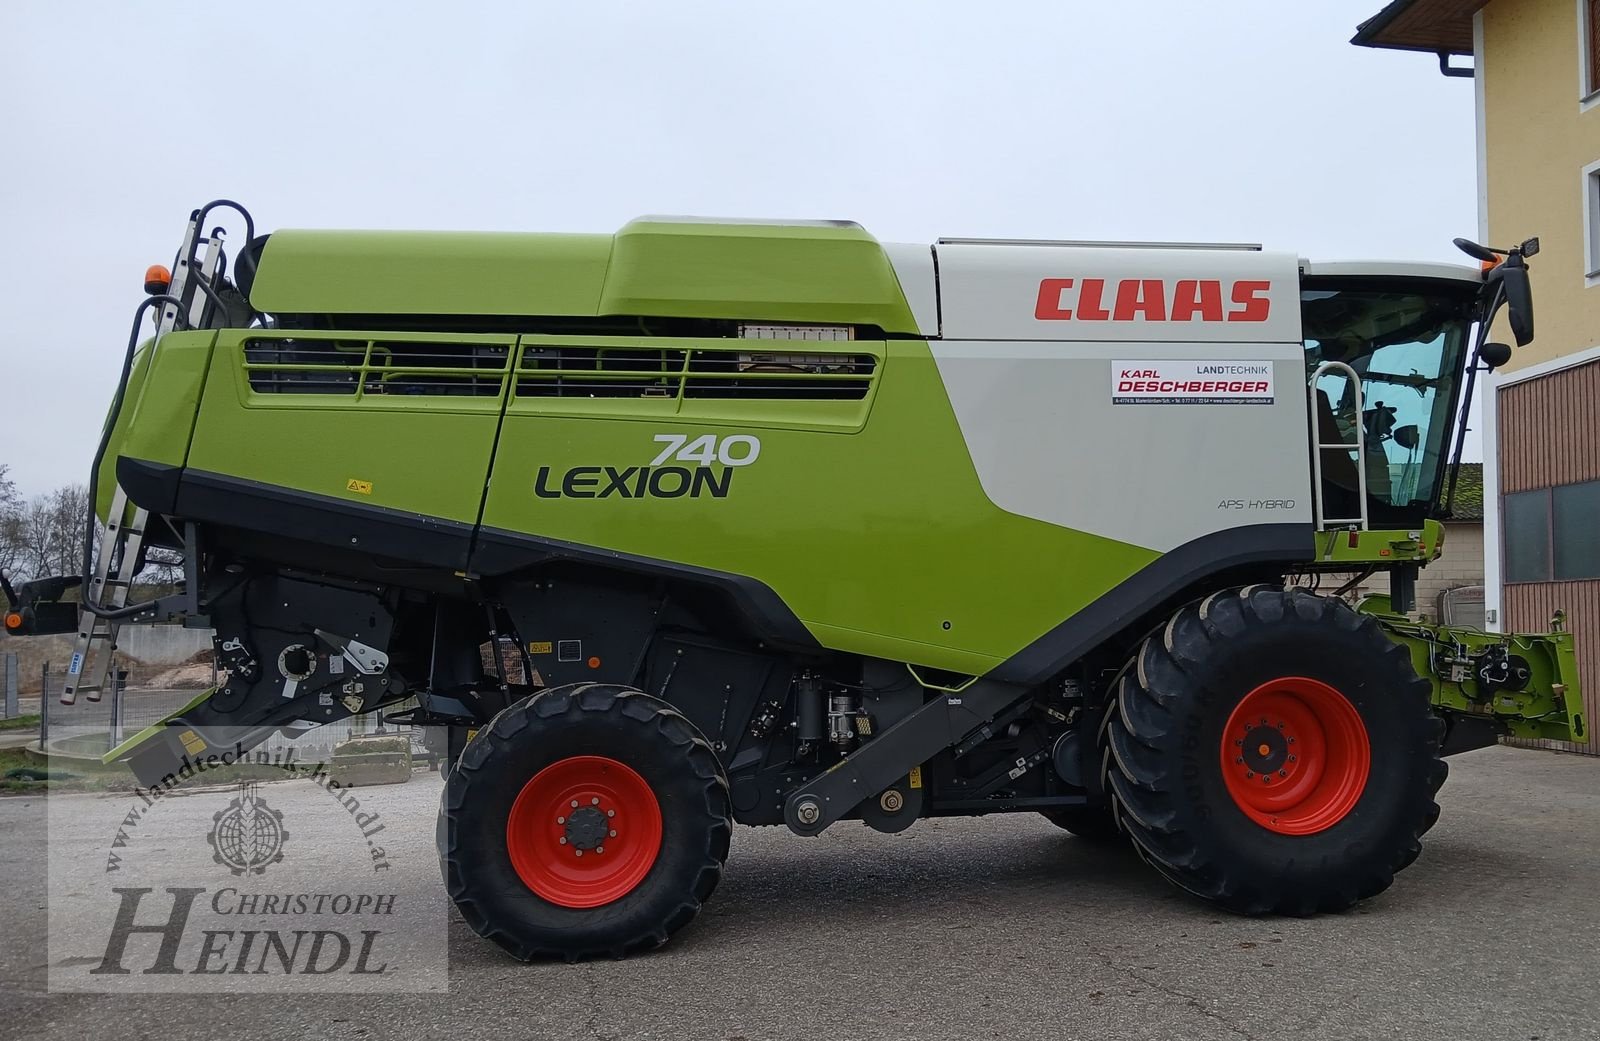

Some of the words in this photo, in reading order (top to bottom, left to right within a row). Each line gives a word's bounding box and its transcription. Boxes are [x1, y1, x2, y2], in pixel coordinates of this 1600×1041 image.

[1034, 278, 1271, 322] CLAAS
[1120, 369, 1161, 379] KARL
[1196, 365, 1268, 375] LANDTECHNIK
[1118, 381, 1269, 393] DESCHBERGER
[648, 433, 761, 467] 740
[533, 466, 734, 499] LEXION
[1217, 499, 1245, 509] APS
[1248, 499, 1295, 509] HYBRID
